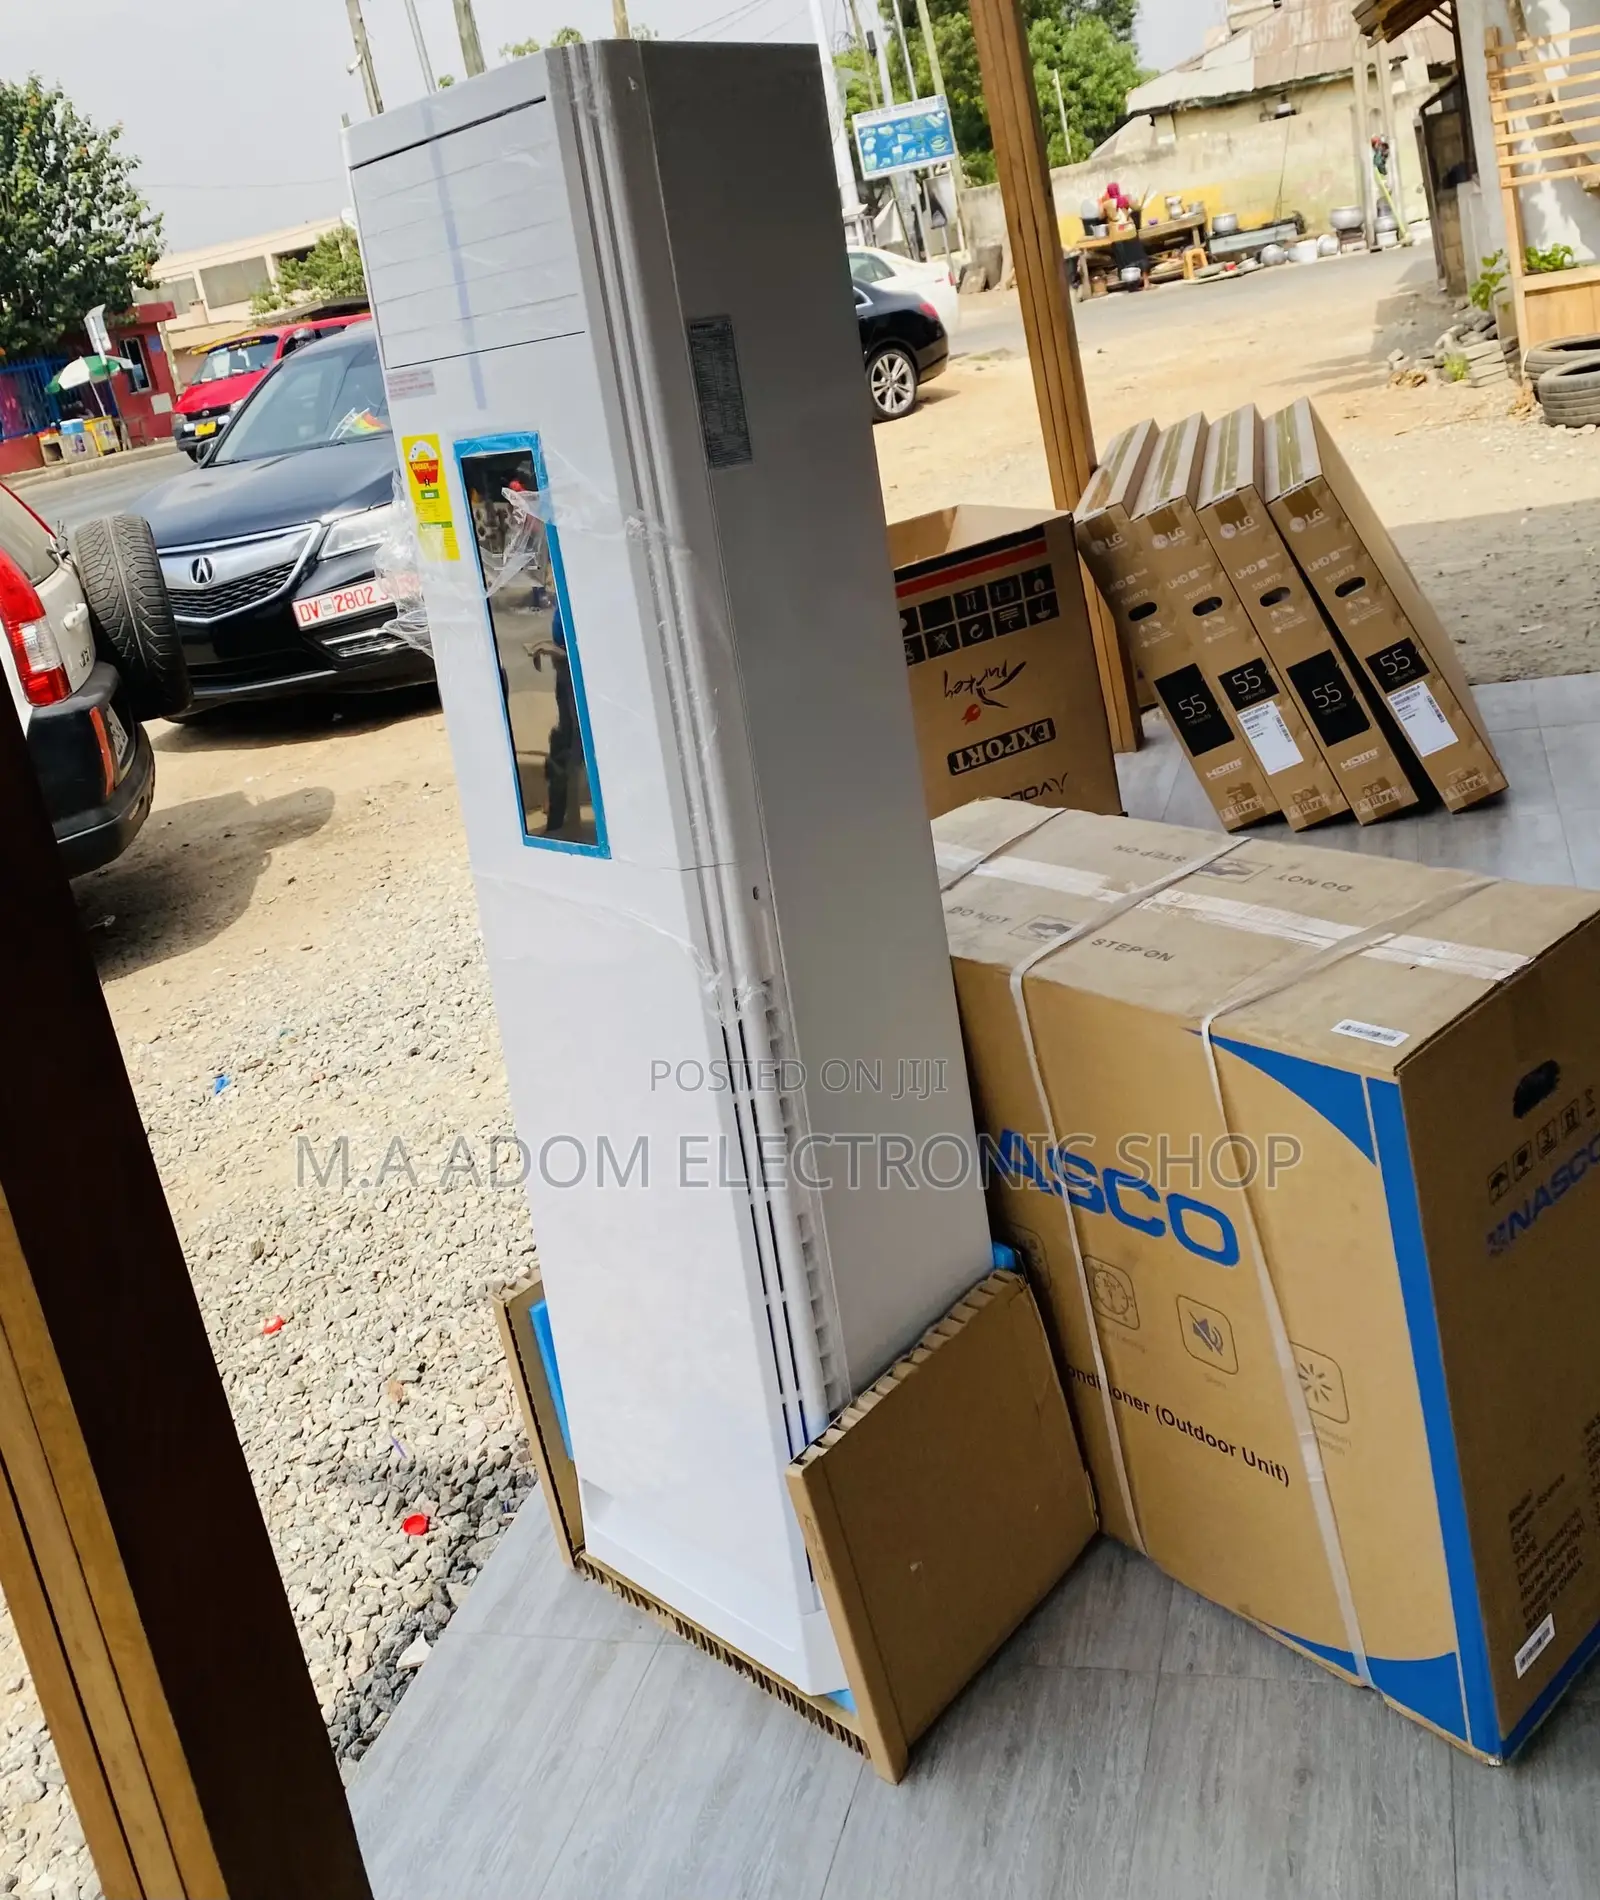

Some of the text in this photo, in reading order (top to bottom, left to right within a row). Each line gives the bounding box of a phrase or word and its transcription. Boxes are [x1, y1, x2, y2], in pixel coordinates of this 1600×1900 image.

[1236, 515, 1255, 531] LG
[1305, 508, 1325, 523] LG
[1105, 533, 1123, 548] LG
[1168, 527, 1186, 541] LG
[1166, 574, 1189, 589] UHD
[1235, 564, 1258, 580] UHD
[298, 601, 319, 622] DV
[334, 586, 376, 613] 2802
[1379, 648, 1411, 676] 55
[1231, 668, 1262, 695] 55
[1311, 681, 1342, 709] 55
[1178, 694, 1207, 720] 55
[952, 719, 1051, 774] EXPORT
[1001, 772, 1068, 801] AVOL
[1141, 851, 1187, 863] STEP
[1274, 875, 1354, 892] DO NOT
[946, 906, 1012, 924] DO NOT
[1092, 938, 1177, 962] STEP ON
[1155, 1404, 1236, 1458] (Outdoor
[1242, 1445, 1291, 1488] Unit)
